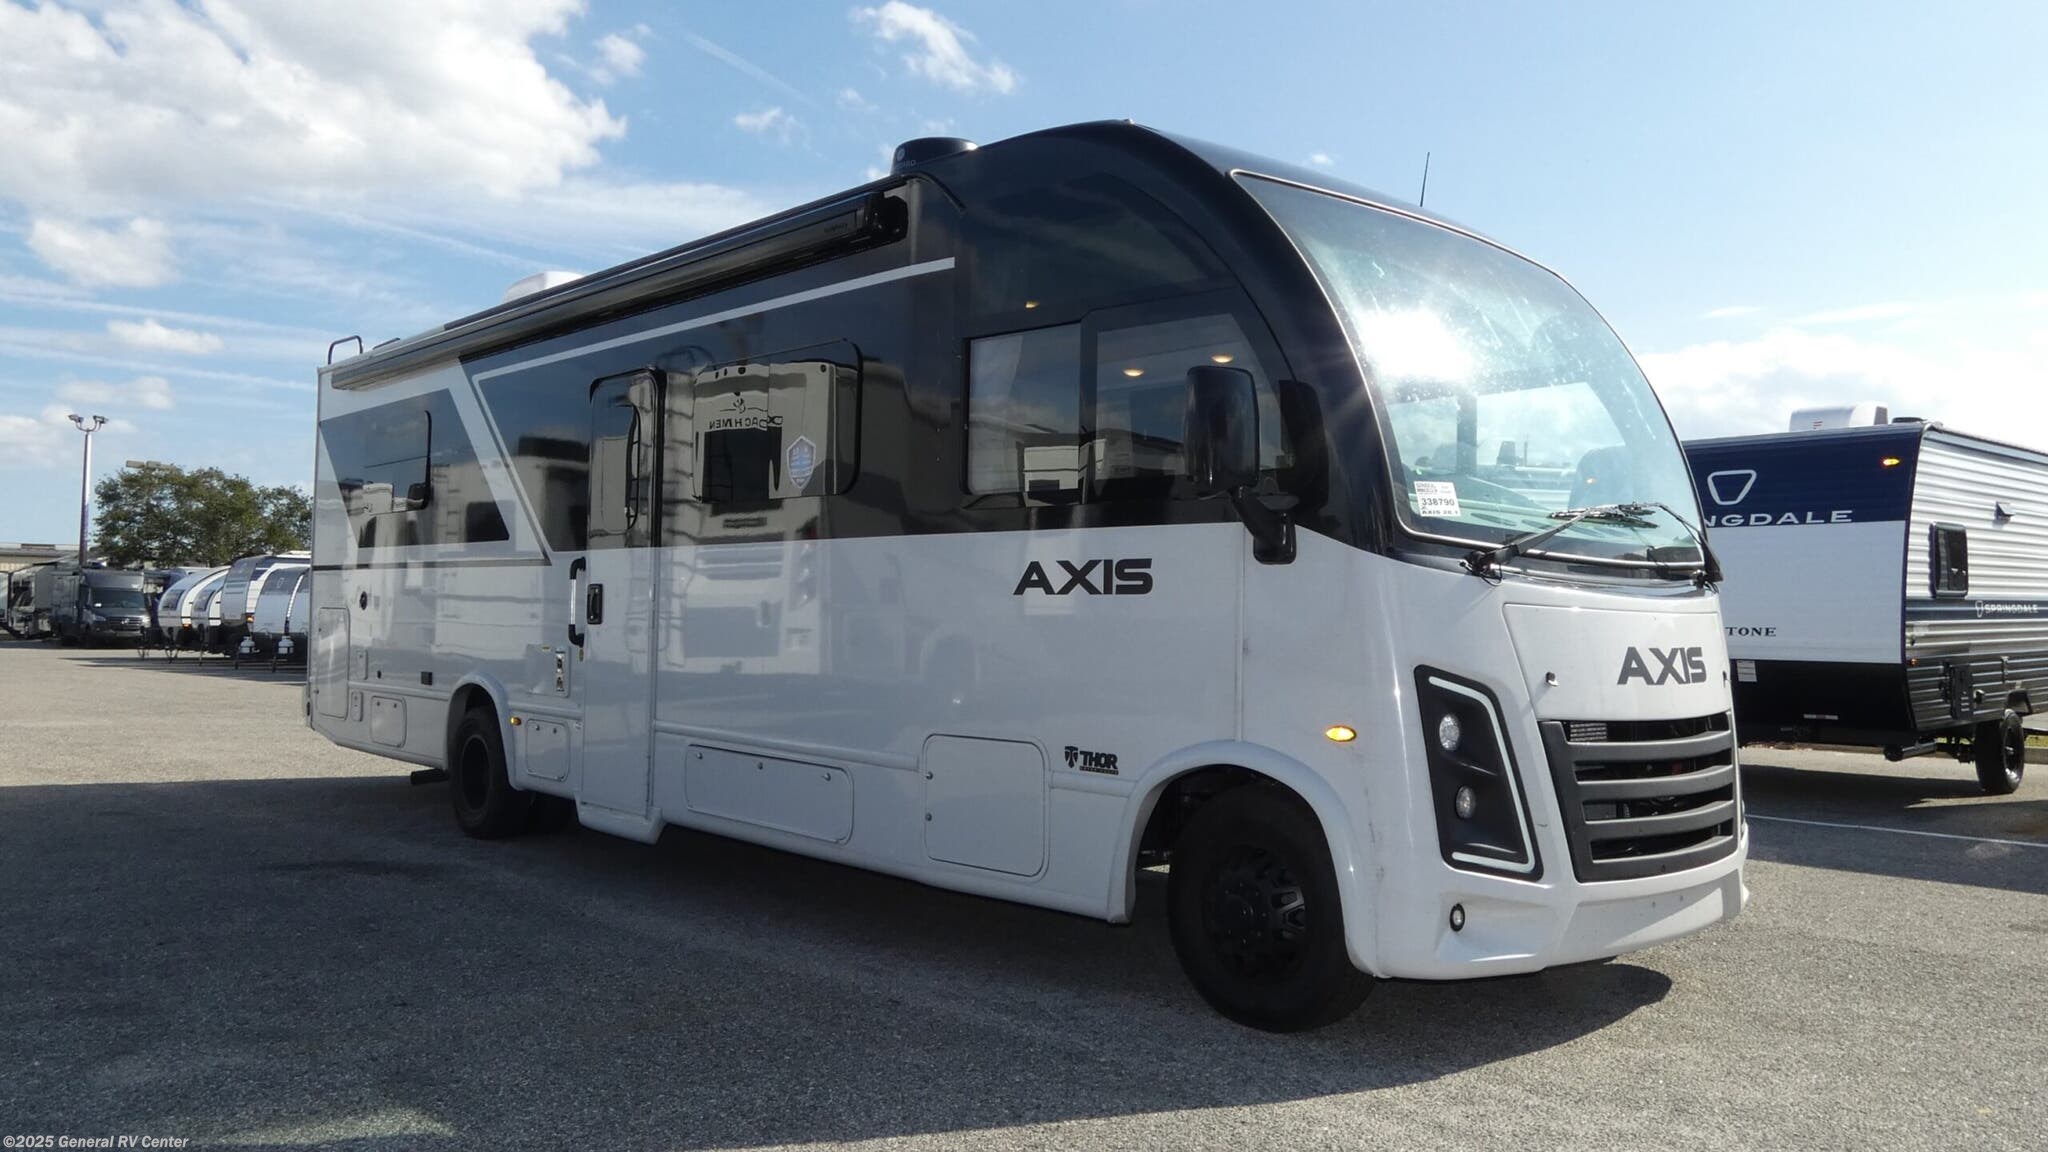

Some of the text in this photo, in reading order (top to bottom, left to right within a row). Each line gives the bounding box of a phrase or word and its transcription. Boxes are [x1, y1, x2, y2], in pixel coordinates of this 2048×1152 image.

[1421, 498, 1455, 506] 338790
[1013, 558, 1153, 595] AXIS
[1984, 604, 2039, 614] SPRINGDALE
[1617, 646, 1707, 685] AXIS
[1079, 750, 1118, 769] THOR
